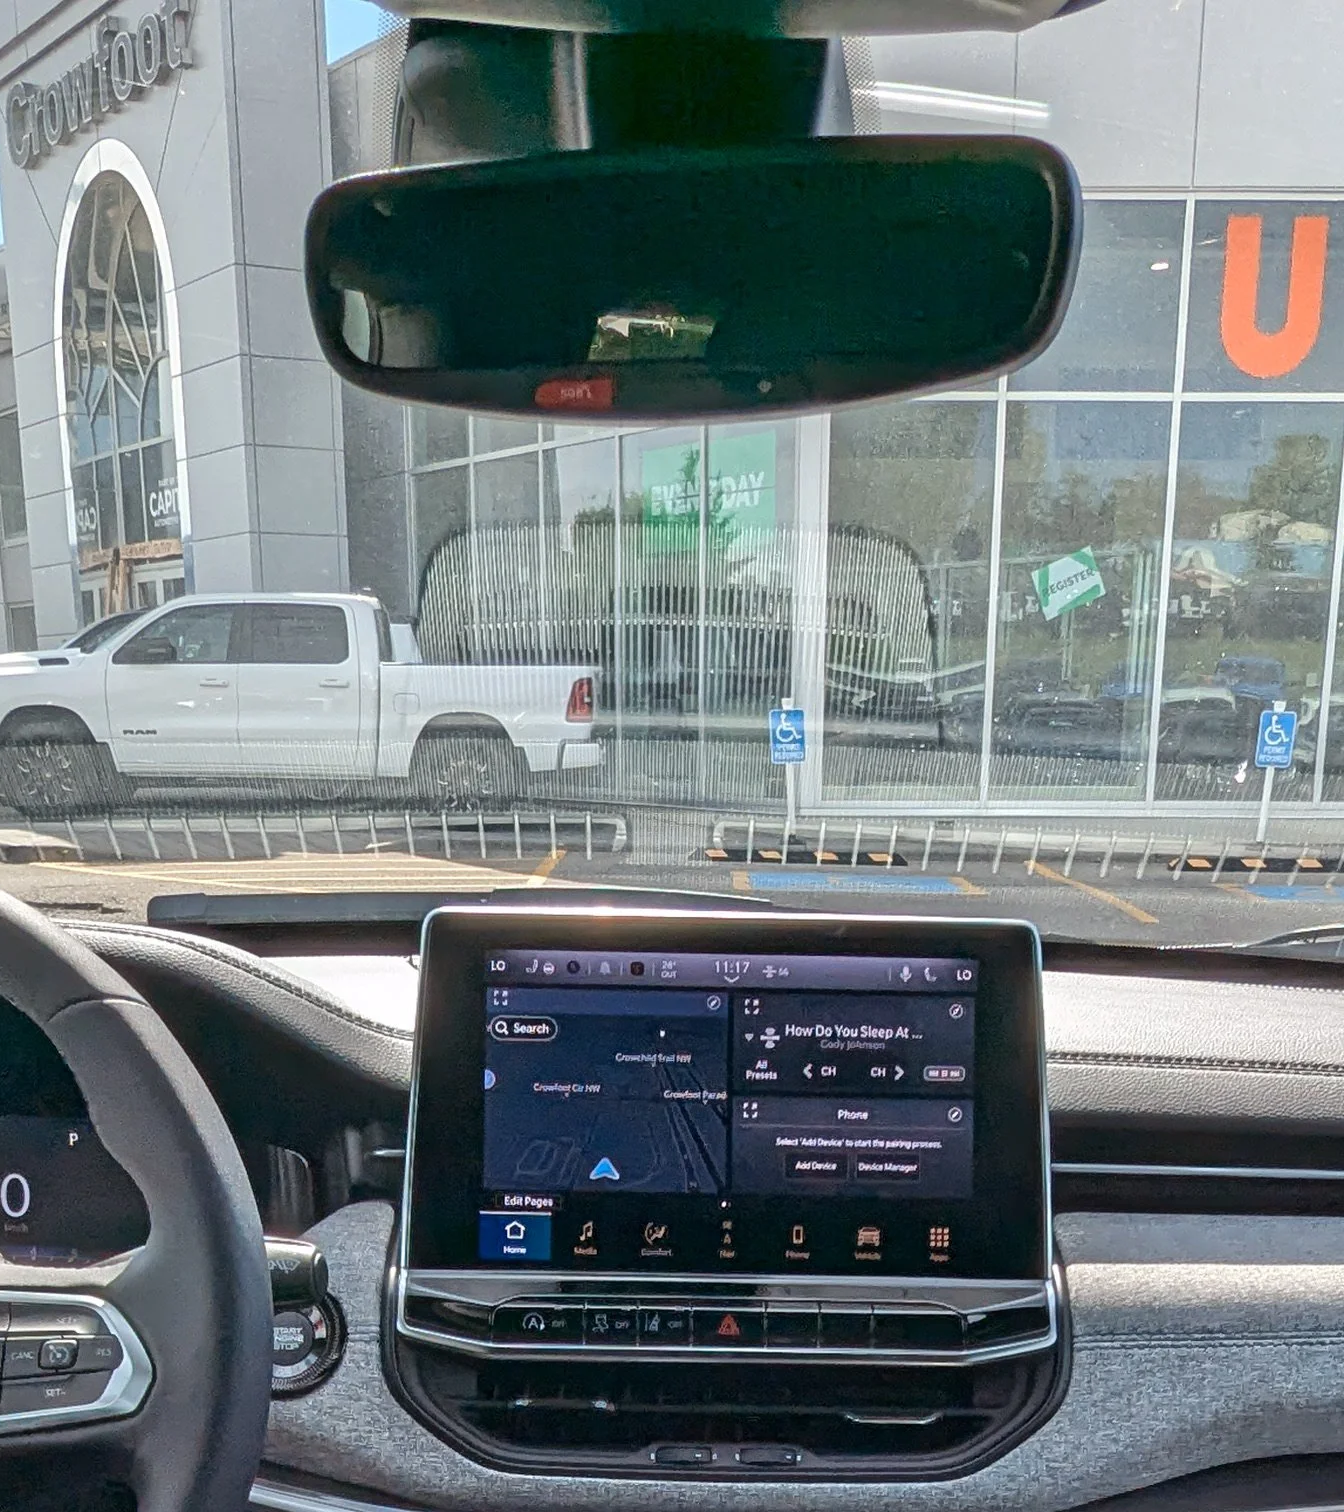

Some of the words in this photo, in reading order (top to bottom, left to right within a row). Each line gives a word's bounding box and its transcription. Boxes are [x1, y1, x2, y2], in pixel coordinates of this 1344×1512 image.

[7, 0, 192, 168] Crowfoot
[722, 471, 764, 509] DAY
[1042, 568, 1095, 598] REGISTER
[490, 960, 506, 972] LO
[714, 960, 750, 974] 11:17
[956, 970, 972, 981] LO
[513, 1022, 550, 1035] Search
[785, 1024, 814, 1037] How
[815, 1025, 833, 1038] Do
[834, 1025, 858, 1038] You
[860, 1025, 893, 1041] Sleep
[894, 1026, 910, 1038] At
[746, 1070, 778, 1081] Presets
[821, 1066, 837, 1077] CH
[870, 1067, 886, 1078] CH
[837, 1109, 868, 1121] Phone
[68, 1132, 79, 1146] P
[845, 1139, 853, 1148] to
[873, 1139, 884, 1148] the
[795, 1161, 811, 1171] Add
[812, 1161, 837, 1171] Device
[858, 1162, 883, 1172] Device
[884, 1162, 917, 1174] Manager
[0, 1172, 31, 1218] 0
[504, 1196, 523, 1207] Edit
[524, 1196, 553, 1208] Pages
[503, 1246, 527, 1255] Home
